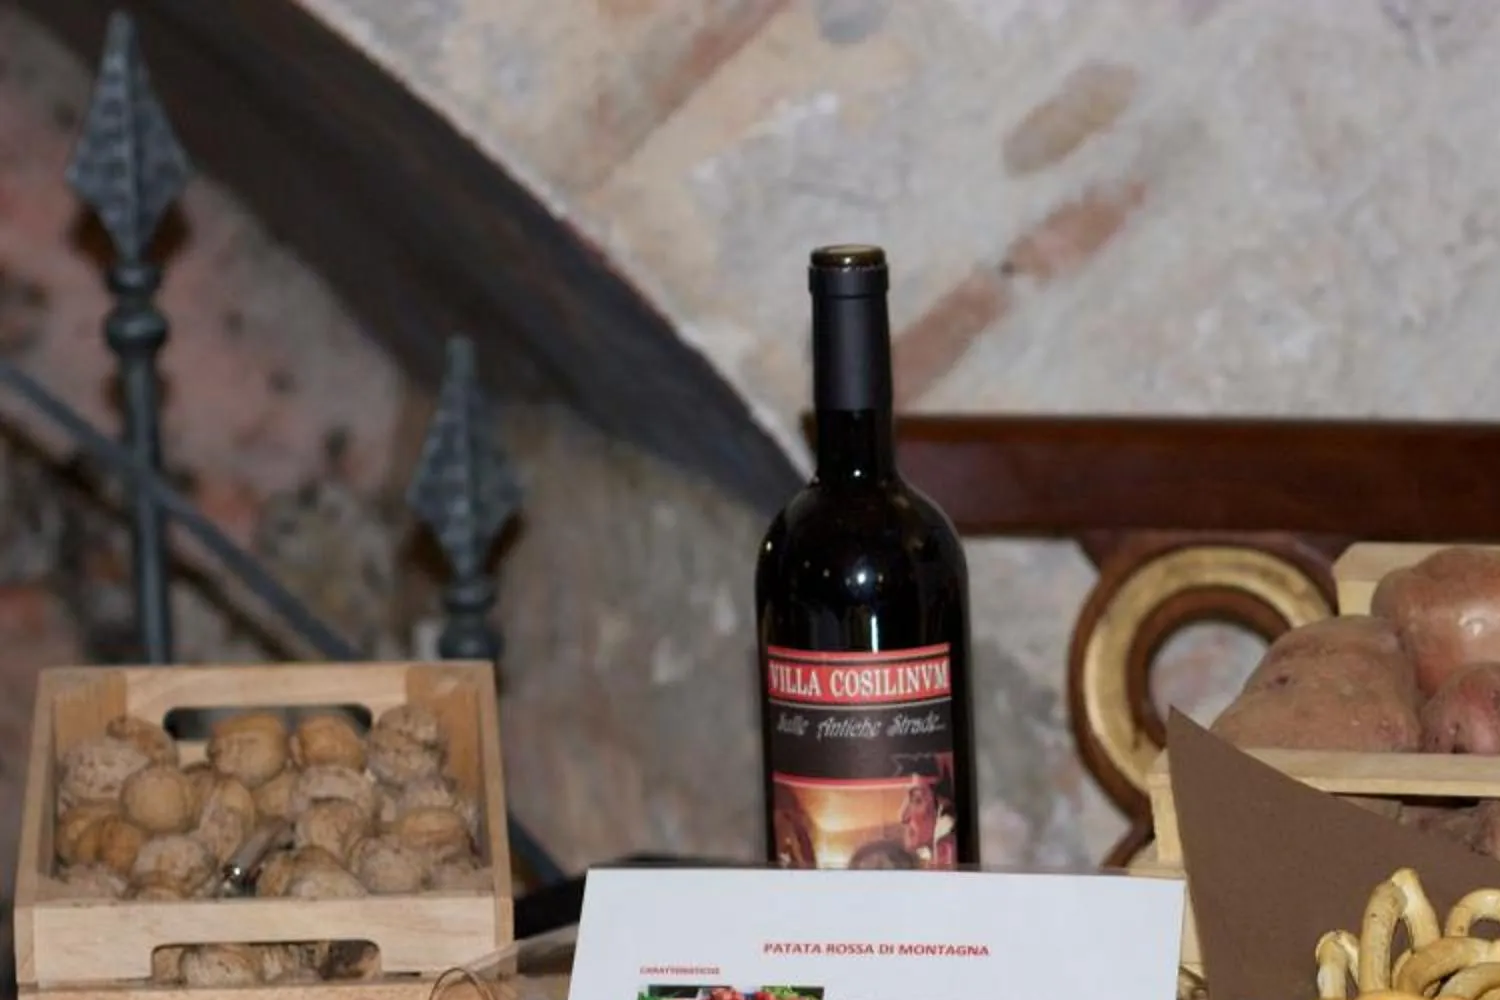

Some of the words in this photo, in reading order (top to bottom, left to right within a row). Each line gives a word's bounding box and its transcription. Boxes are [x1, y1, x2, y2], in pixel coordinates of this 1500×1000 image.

[769, 663, 823, 697] VILLA
[829, 662, 950, 697] COSILINVM
[763, 942, 822, 955] PATATA
[825, 942, 875, 956] ROSSA
[878, 943, 894, 956] DI
[897, 943, 990, 957] MONTAGNA
